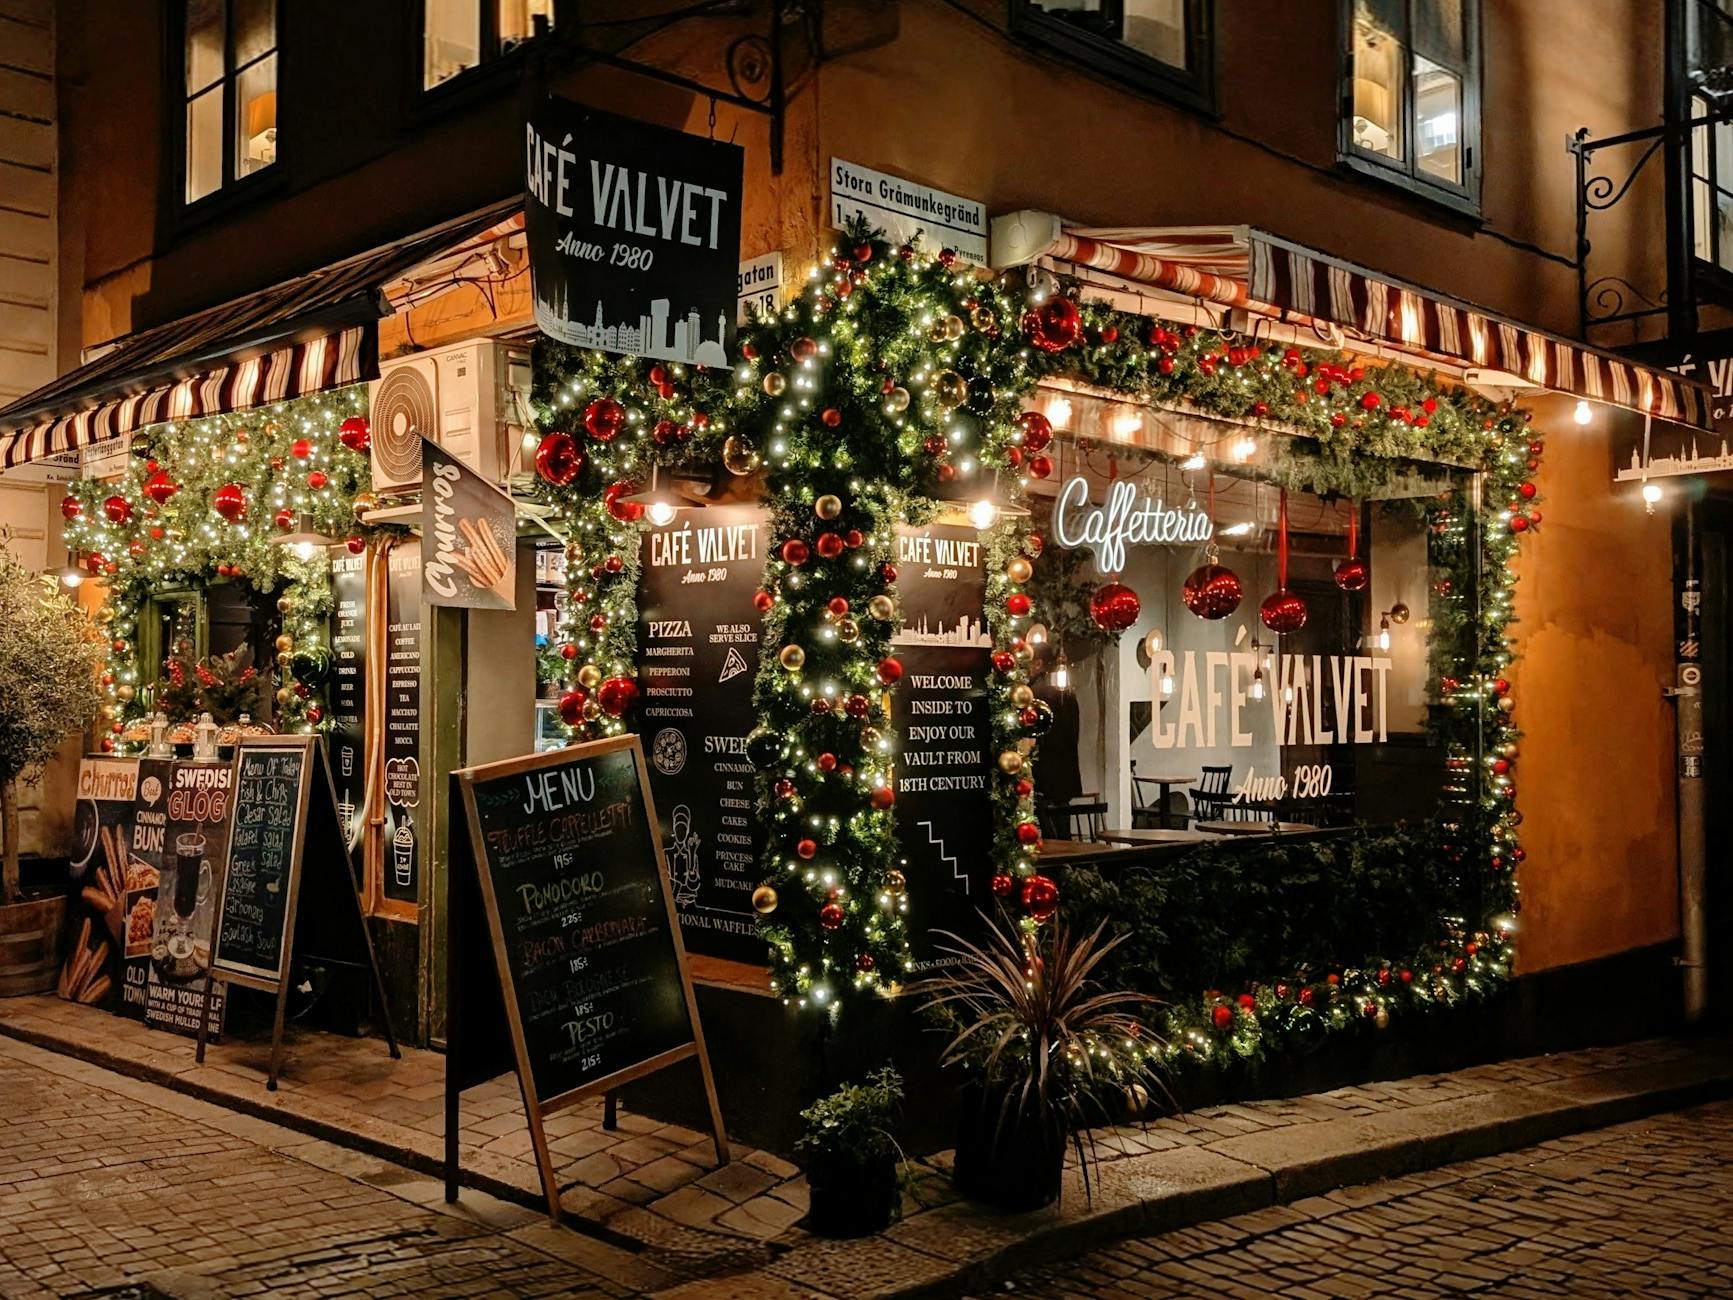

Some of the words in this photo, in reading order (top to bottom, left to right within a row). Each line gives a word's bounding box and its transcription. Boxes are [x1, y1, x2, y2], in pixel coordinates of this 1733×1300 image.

[526, 121, 576, 218] CAFÉ
[590, 159, 728, 250] VALVET
[836, 166, 872, 195] Stora
[879, 179, 980, 226] Gråmunkegränd
[555, 231, 605, 262] Anno
[609, 243, 654, 272] 1980
[425, 462, 462, 598] Churros
[651, 521, 693, 567] CAFÉ
[697, 524, 759, 563] VALVET
[900, 532, 931, 564] CAFÉ
[935, 540, 980, 568] VALVET
[681, 569, 706, 584] Anno
[707, 568, 727, 582] 1980
[648, 621, 693, 639] PIZZA
[716, 625, 729, 634] WE
[730, 624, 750, 634] ALSO
[709, 634, 734, 644] SERVE
[735, 633, 758, 643] SLICE
[390, 652, 420, 660] AMERICANO
[646, 647, 694, 656] MARGHERITA
[389, 666, 421, 674] CAPPUCCINO
[649, 667, 690, 677] PEPPERONI
[392, 680, 417, 688] ESPRESSO
[911, 675, 972, 690] WELCOME
[1151, 624, 1253, 749] CAFÉ
[1269, 654, 1393, 746] VALVET
[399, 694, 410, 702] TEA
[646, 688, 693, 697] PROSCIUTTO
[646, 708, 694, 717] CAPRICCIOSA
[911, 701, 954, 715] INSIDE
[955, 701, 972, 714] TO
[402, 723, 419, 731] LATTE
[909, 727, 947, 743] ENJOY
[949, 725, 975, 739] OUR
[395, 737, 413, 745] MOCCA
[904, 751, 945, 766] VAULT
[947, 751, 981, 765] FROM
[243, 757, 264, 776] Menu
[714, 762, 757, 774] CINNAMON
[388, 772, 418, 781] CHOCOLATE
[240, 780, 254, 800] Fish
[256, 780, 263, 801] &
[265, 778, 288, 804] Chips
[523, 767, 595, 814] MENU
[726, 781, 744, 791] BUN
[899, 778, 928, 793] 18TH
[929, 776, 986, 792] CENTURY
[1232, 767, 1287, 805] Anno
[1292, 764, 1333, 799] 1980
[389, 788, 401, 796] OLD
[401, 789, 416, 797] TOWN
[168, 782, 229, 823] GLÖG
[719, 798, 750, 809] CHEESE
[236, 803, 265, 825] Caesar
[268, 805, 293, 826] Salad
[722, 816, 748, 827] CAKES
[717, 833, 752, 845] COOKIES
[715, 850, 754, 863] PRINCESS
[723, 861, 745, 873] CAKE
[714, 877, 754, 891] MUDCAKE
[516, 871, 604, 913] POMODORO
[713, 919, 760, 937] WAFFLES
[127, 965, 145, 984] OLD
[149, 984, 175, 1002] WARM
[166, 1003, 177, 1011] CUP
[177, 1006, 185, 1014] OF
[146, 1008, 174, 1023] SWEDISH
[175, 1014, 201, 1029] MULLED
[561, 1011, 614, 1045] PESTO
